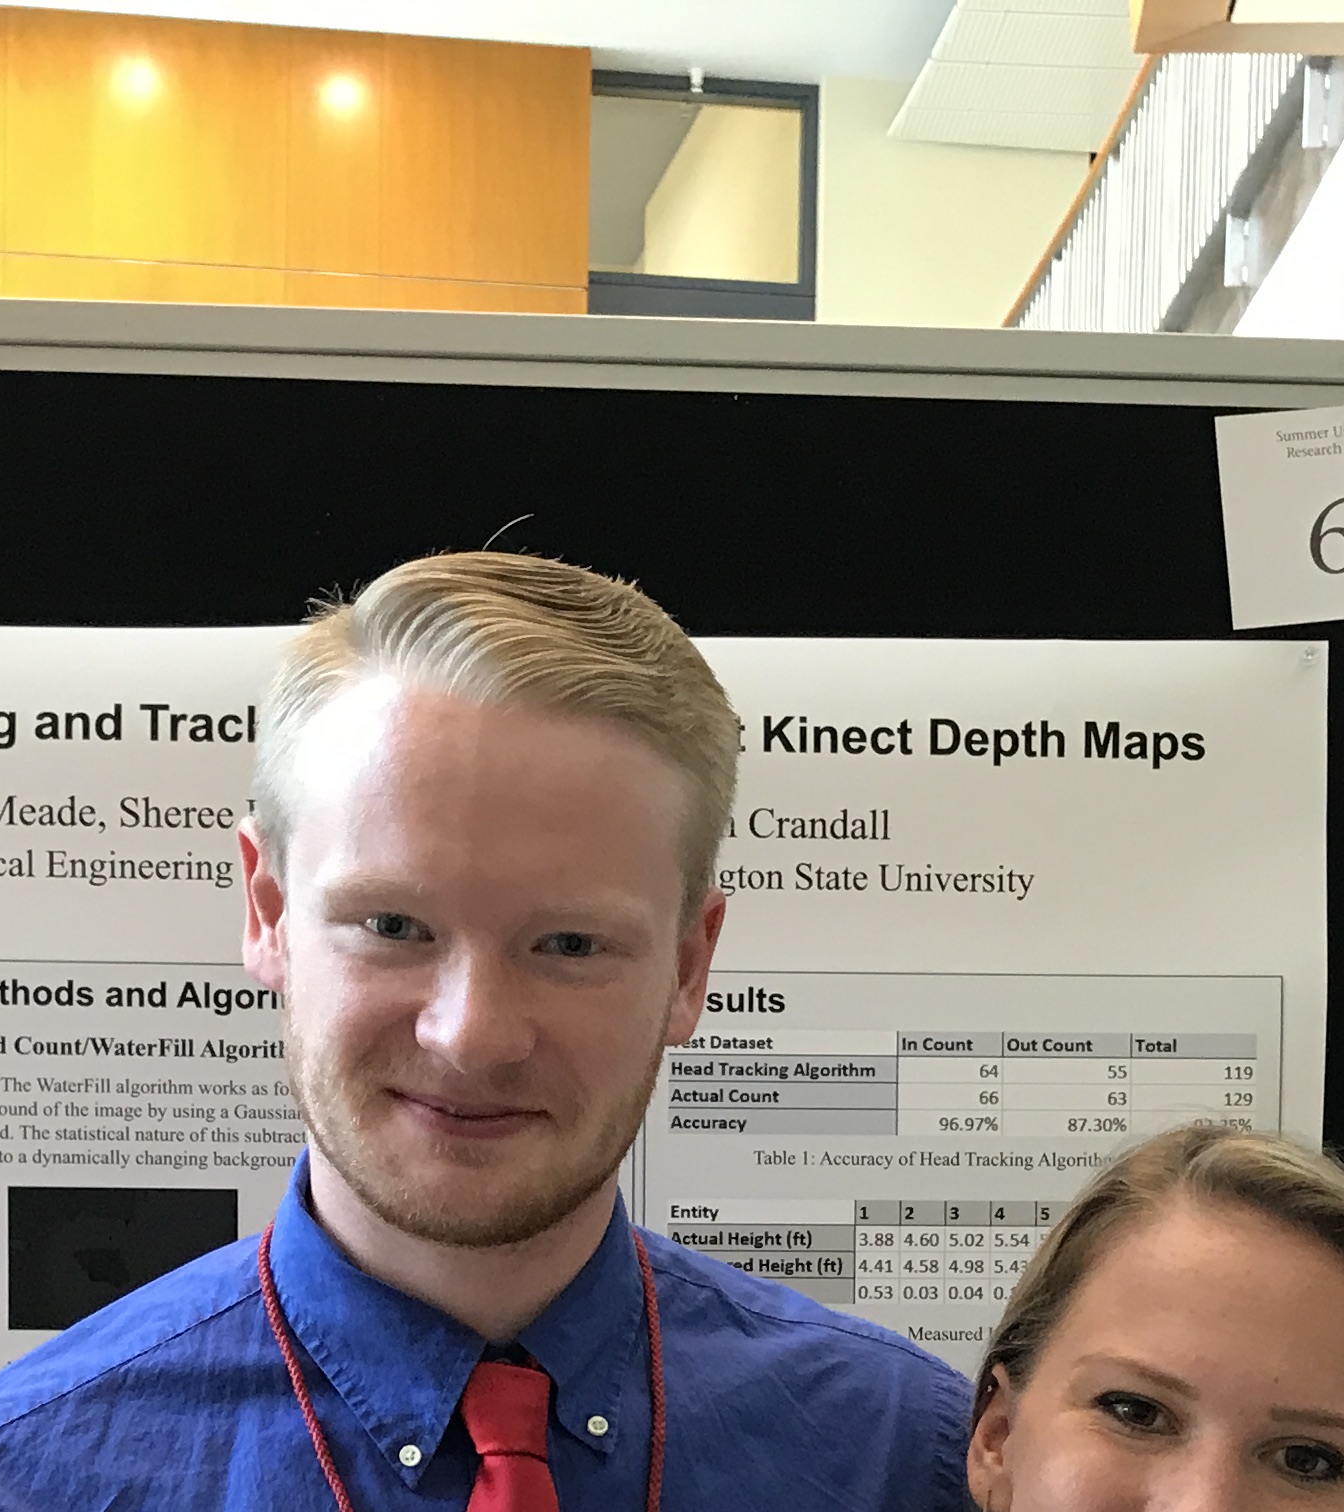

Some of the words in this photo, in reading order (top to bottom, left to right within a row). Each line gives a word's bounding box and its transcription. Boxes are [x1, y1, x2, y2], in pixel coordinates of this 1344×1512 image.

[1275, 424, 1330, 444] Summer
[1285, 441, 1343, 460] Research
[34, 702, 123, 742] and
[762, 714, 913, 755] Kinect
[928, 716, 1066, 766] Depth
[1083, 721, 1206, 769] Maps
[119, 796, 234, 829] Sheree
[748, 806, 891, 842] Crandall
[46, 850, 233, 888] Engineering
[794, 862, 869, 891] State
[878, 864, 1035, 900] University
[105, 979, 167, 1008] and
[177, 980, 285, 1016] Algori
[706, 984, 787, 1014] sults
[13, 1036, 195, 1058] Count/WaterFill
[709, 1035, 774, 1050] Dataset
[901, 1037, 919, 1052] In
[921, 1037, 974, 1053] Count
[1006, 1037, 1039, 1053] Out
[1041, 1038, 1094, 1053] Count
[1134, 1037, 1177, 1053] Total
[671, 1061, 714, 1078] Head
[717, 1061, 790, 1082] Tracking
[792, 1061, 877, 1081] Algorithm
[979, 1064, 999, 1080] 64
[1107, 1065, 1127, 1080] 55
[1224, 1065, 1254, 1081] 119
[670, 1087, 725, 1103] Actual
[727, 1089, 781, 1105] Count
[979, 1091, 999, 1106] 66
[1107, 1091, 1127, 1106] 63
[1224, 1092, 1253, 1107] 129
[669, 1115, 748, 1134] Accuracy
[939, 1117, 999, 1132] 96.97%
[1067, 1118, 1127, 1132] 87.30%
[753, 1149, 797, 1167] Table
[803, 1150, 815, 1167] 1:
[819, 1150, 894, 1171] Accuracy
[897, 1151, 918, 1168] of
[919, 1151, 961, 1169] Head
[964, 1151, 1034, 1172] Tracking
[670, 1205, 720, 1222] Entity
[859, 1206, 869, 1220] 1
[904, 1206, 915, 1220] 2
[949, 1206, 960, 1220] 3
[994, 1206, 1005, 1220] 4
[1039, 1207, 1050, 1221] 5
[671, 1231, 724, 1246] Actual
[727, 1231, 783, 1249] Height
[786, 1230, 813, 1250] (ft)
[858, 1232, 895, 1247] 3.88
[903, 1232, 940, 1247] 4.60
[949, 1233, 985, 1247] 5.02
[994, 1233, 1030, 1248] 5.54
